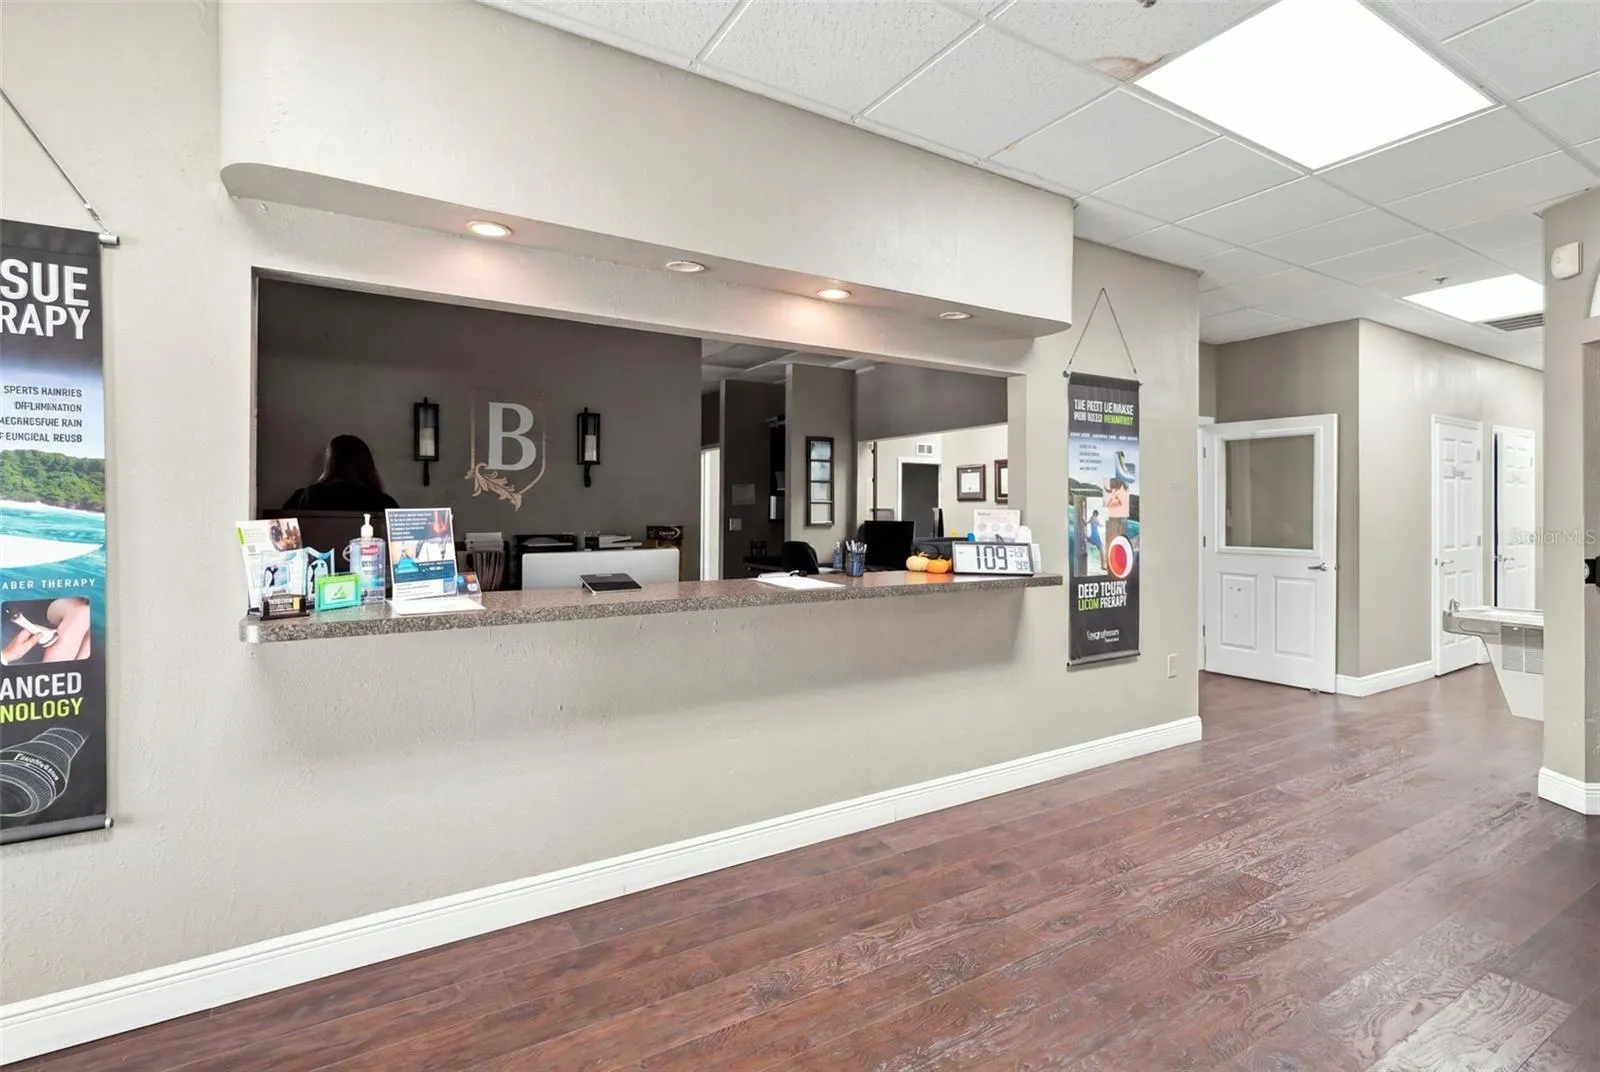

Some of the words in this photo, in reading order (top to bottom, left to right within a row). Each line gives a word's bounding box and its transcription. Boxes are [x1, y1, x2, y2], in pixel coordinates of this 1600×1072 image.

[0, 257, 90, 308] SUE
[0, 300, 91, 340] RAPY
[485, 402, 537, 471] B
[41, 577, 96, 589] THERAPY
[1078, 583, 1099, 599] DEEP
[0, 671, 82, 701] ANCED
[0, 697, 84, 723] NOLOGY
